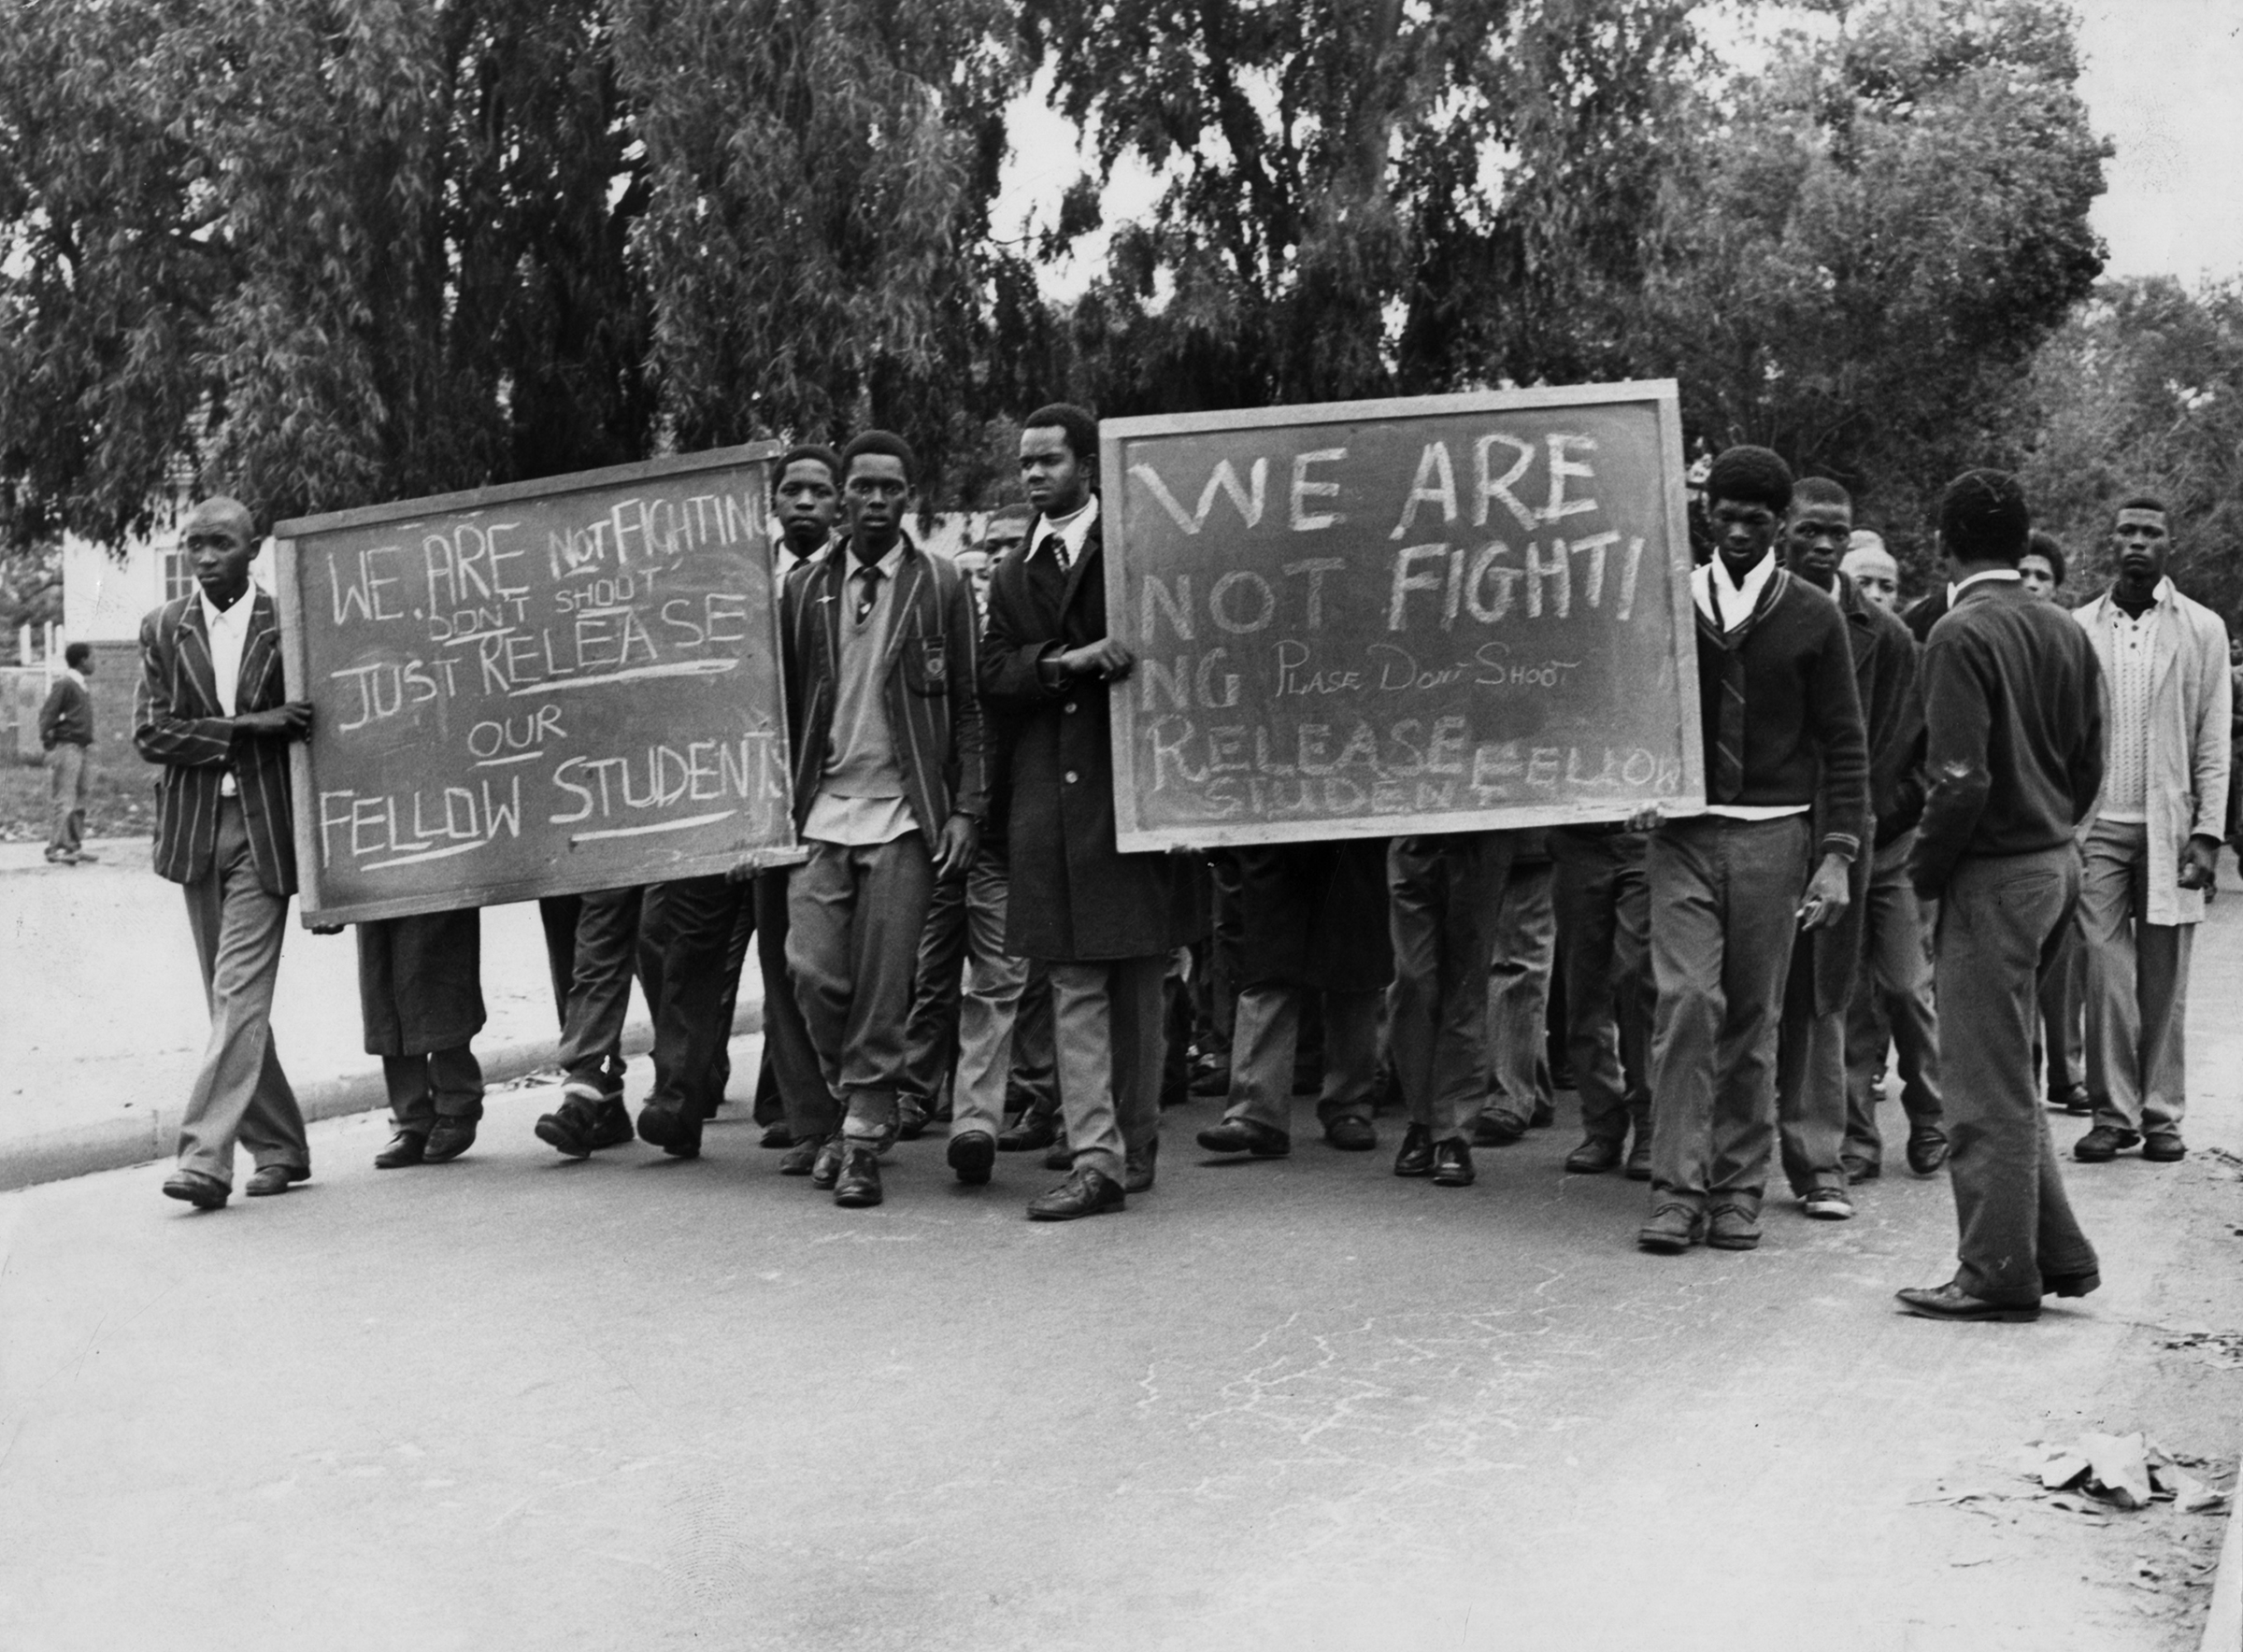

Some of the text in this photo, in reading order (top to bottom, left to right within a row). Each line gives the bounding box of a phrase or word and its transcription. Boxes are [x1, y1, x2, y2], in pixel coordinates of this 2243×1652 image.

[1126, 432, 1598, 540] WE ARE
[423, 521, 530, 620] ARE
[550, 520, 611, 579] NOT
[1139, 557, 1346, 643] NOT
[330, 592, 747, 733] JUST RELEASE
[1140, 647, 1241, 711] NG
[468, 704, 566, 757] OUR
[1146, 713, 1466, 792] RELEASE
[320, 775, 520, 868] FELLOW
